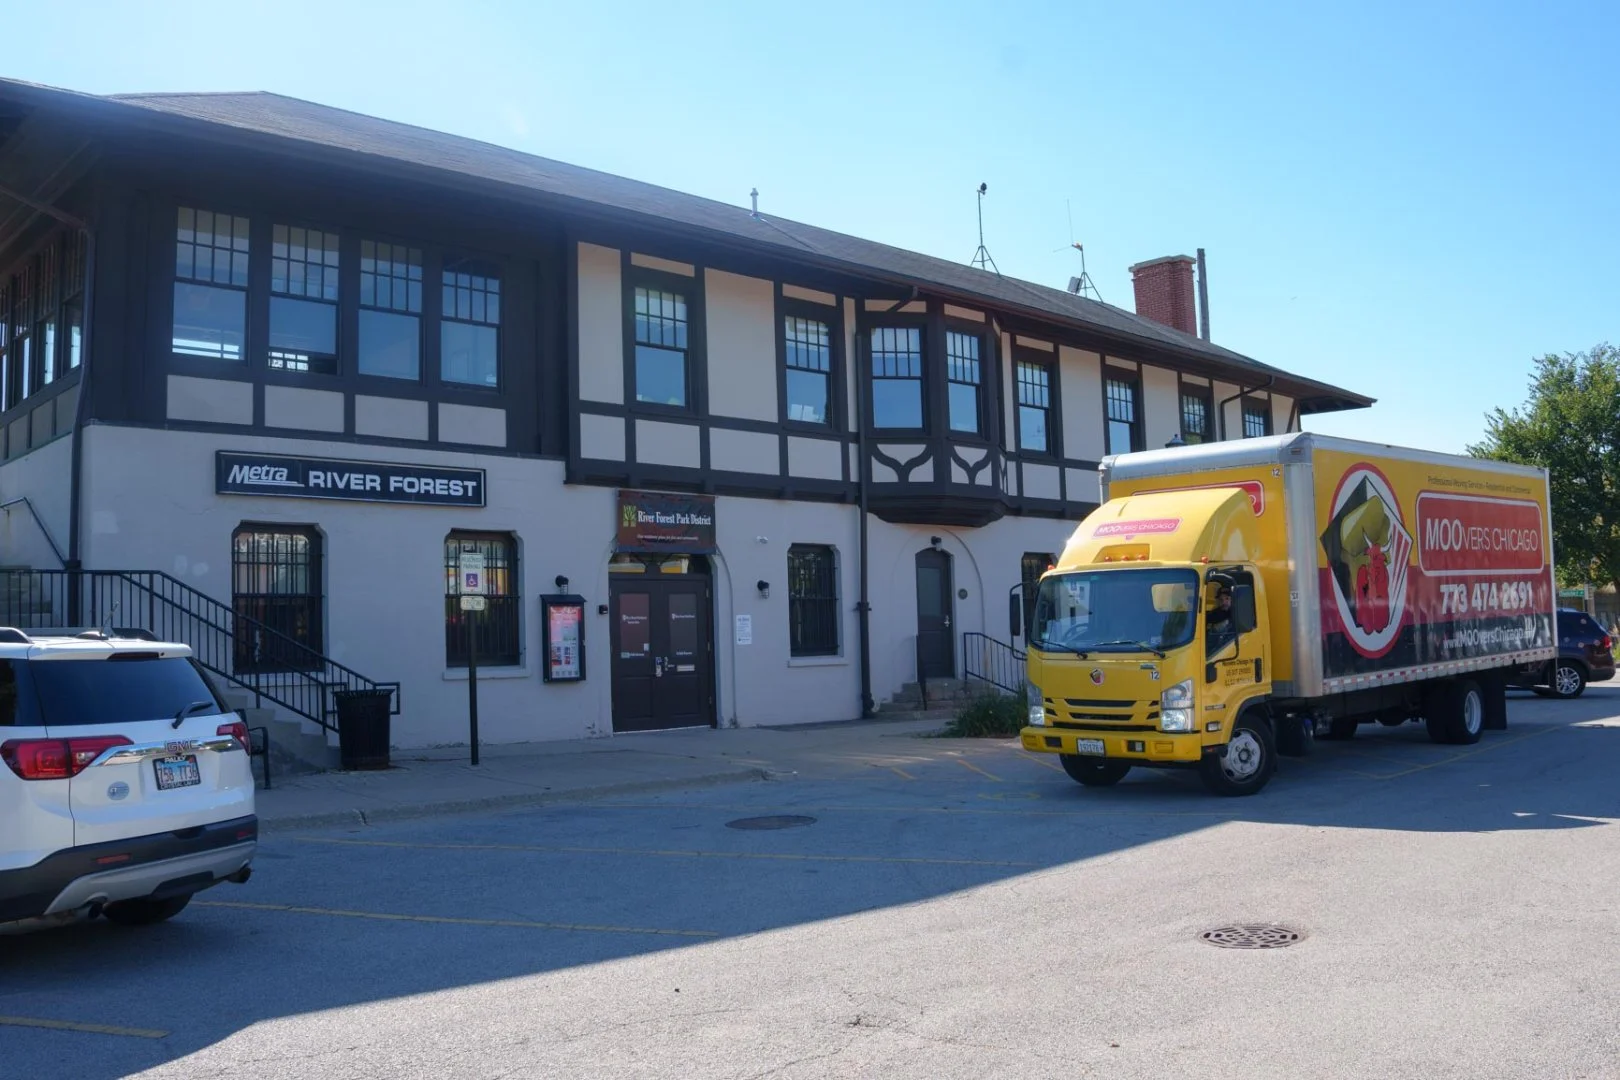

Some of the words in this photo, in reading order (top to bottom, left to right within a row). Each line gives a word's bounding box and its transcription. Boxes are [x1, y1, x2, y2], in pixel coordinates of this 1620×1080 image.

[227, 464, 305, 488] Metra
[308, 471, 381, 491] RIVER
[389, 476, 477, 497] FOREST
[637, 510, 655, 523] River
[655, 511, 675, 524] Forest
[676, 513, 690, 524] Park
[690, 514, 712, 525] District
[1492, 527, 1539, 552] CHICAGO
[1440, 583, 1468, 615] 773
[1471, 582, 1499, 612] 474
[1501, 581, 1533, 610] 2691
[1151, 671, 1160, 680] 12
[164, 739, 197, 753] GMC
